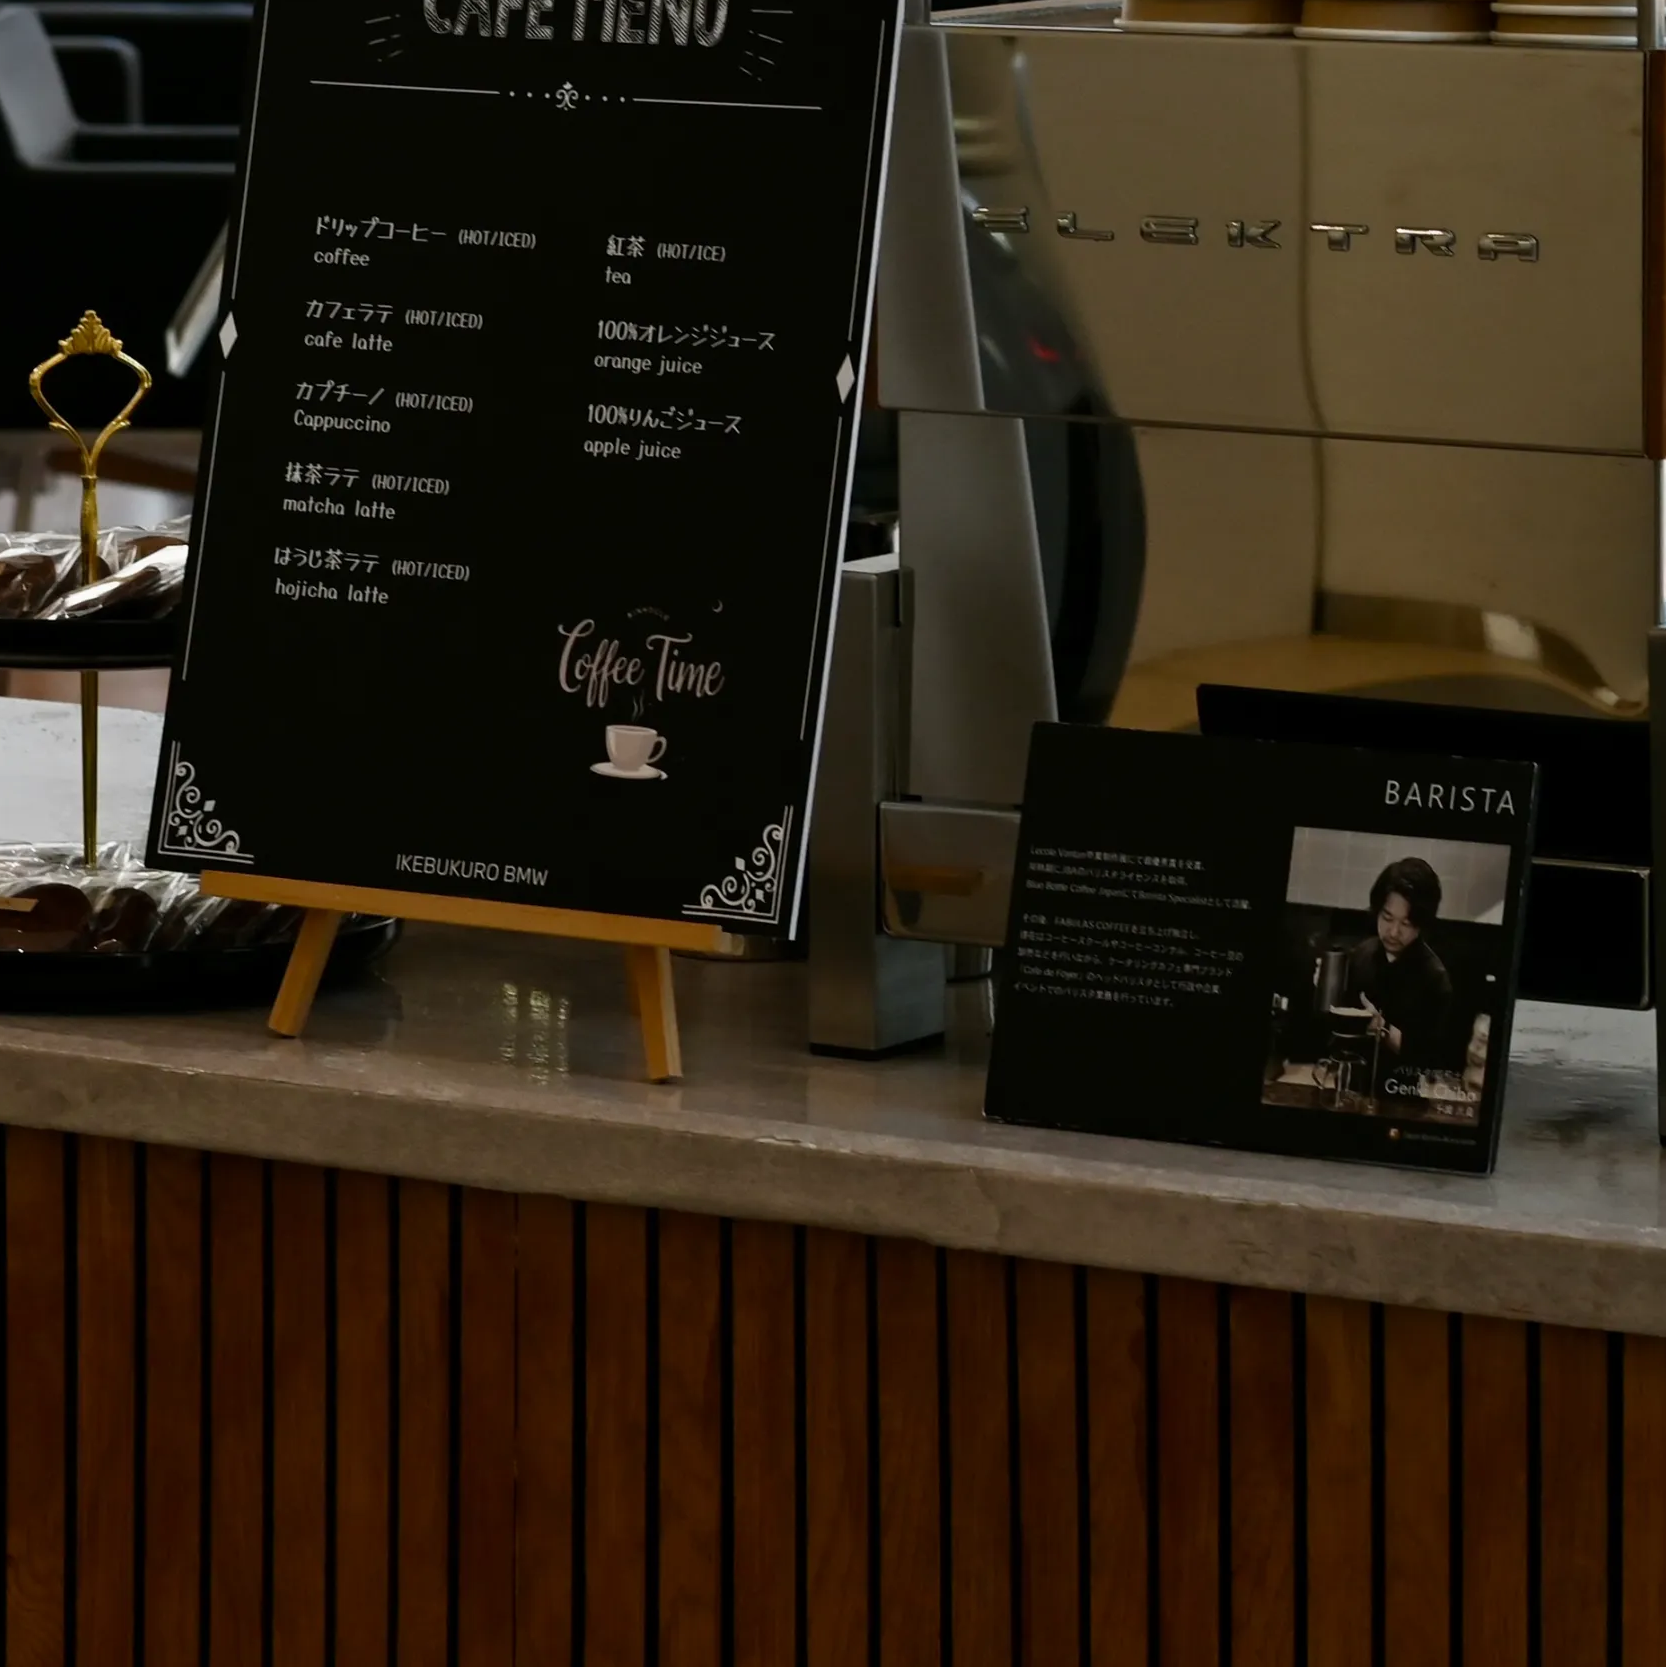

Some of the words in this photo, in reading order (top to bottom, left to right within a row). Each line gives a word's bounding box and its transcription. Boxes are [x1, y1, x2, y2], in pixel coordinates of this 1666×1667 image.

[316, 215, 447, 242] ドリップコーヒー
[458, 228, 537, 250] (HOT/ICED)
[972, 206, 1539, 262] ELEKTRA
[313, 247, 371, 267] coffee
[606, 234, 646, 258] 紅茶
[656, 242, 726, 263] (HOT/ICE)
[605, 265, 632, 285] tea
[306, 299, 394, 324] カフェラテ
[404, 309, 484, 330] (HOT/ICED)
[304, 330, 343, 349] cafe
[351, 332, 393, 352] latte
[593, 355, 652, 375] orange
[656, 355, 703, 376] juice
[296, 379, 385, 406] カプチーノ
[395, 391, 474, 414] (HOT/ICED)
[293, 408, 391, 433] Cappuccino
[583, 437, 631, 458] apple
[635, 439, 682, 461] juice
[284, 461, 360, 488] 抹茶ラテ
[371, 473, 450, 496] (HOT/ICED)
[282, 495, 345, 516] matcha
[354, 499, 396, 520] latte
[391, 559, 470, 582] (HOT/ICED)
[275, 577, 338, 601] hojicha
[347, 583, 389, 605] latte
[557, 618, 645, 708] Coffee
[645, 632, 725, 702] Time
[1384, 779, 1515, 816] BARISTA
[395, 853, 500, 882] IKEBUKURO
[503, 864, 549, 887] BMW
